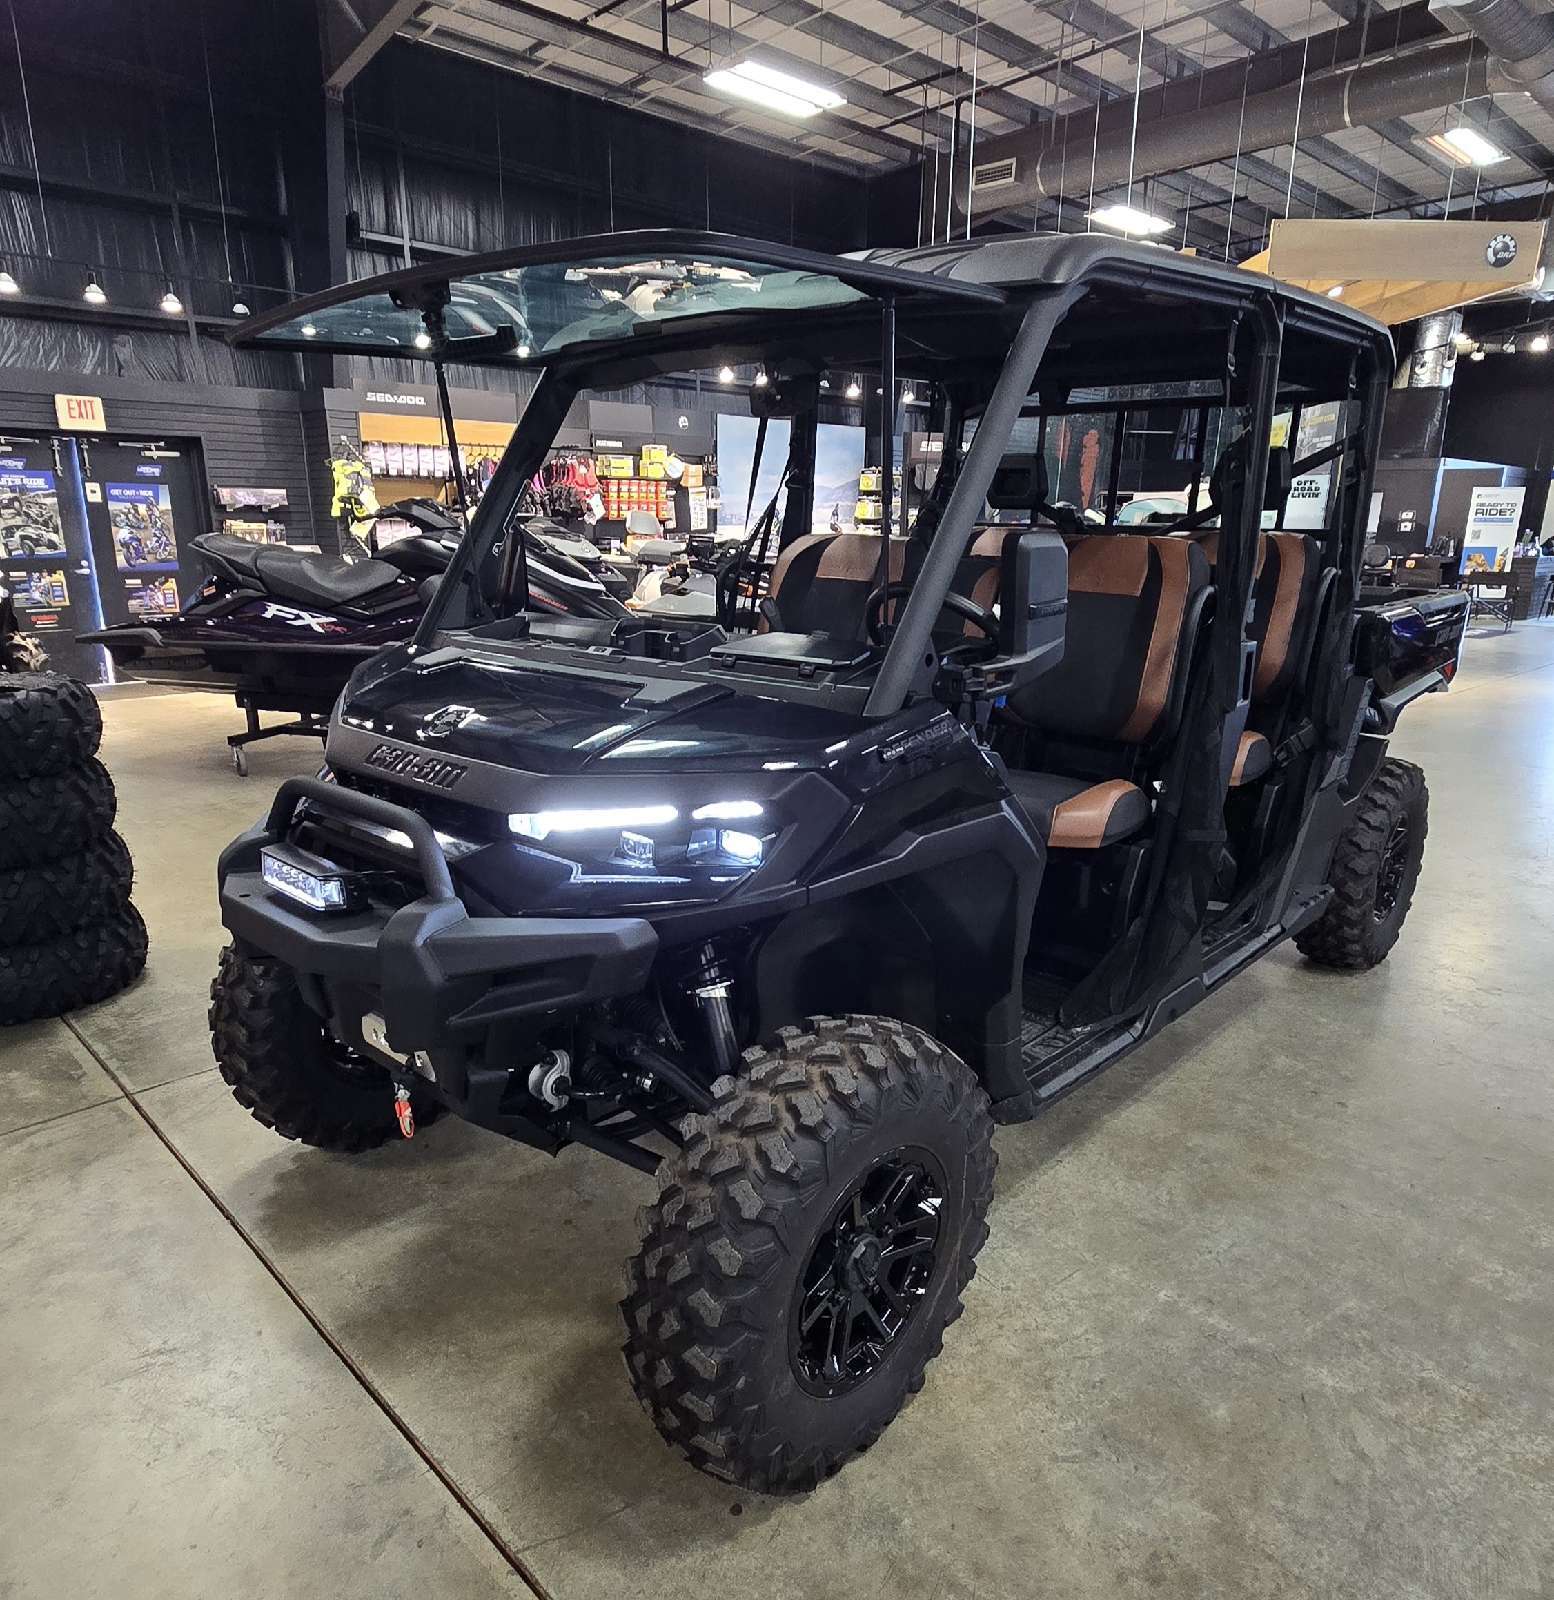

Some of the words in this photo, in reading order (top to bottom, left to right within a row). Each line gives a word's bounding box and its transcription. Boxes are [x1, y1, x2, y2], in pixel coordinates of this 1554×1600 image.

[66, 399, 96, 420] EXIT
[1474, 508, 1516, 517] RIDE?
[261, 601, 338, 634] FX
